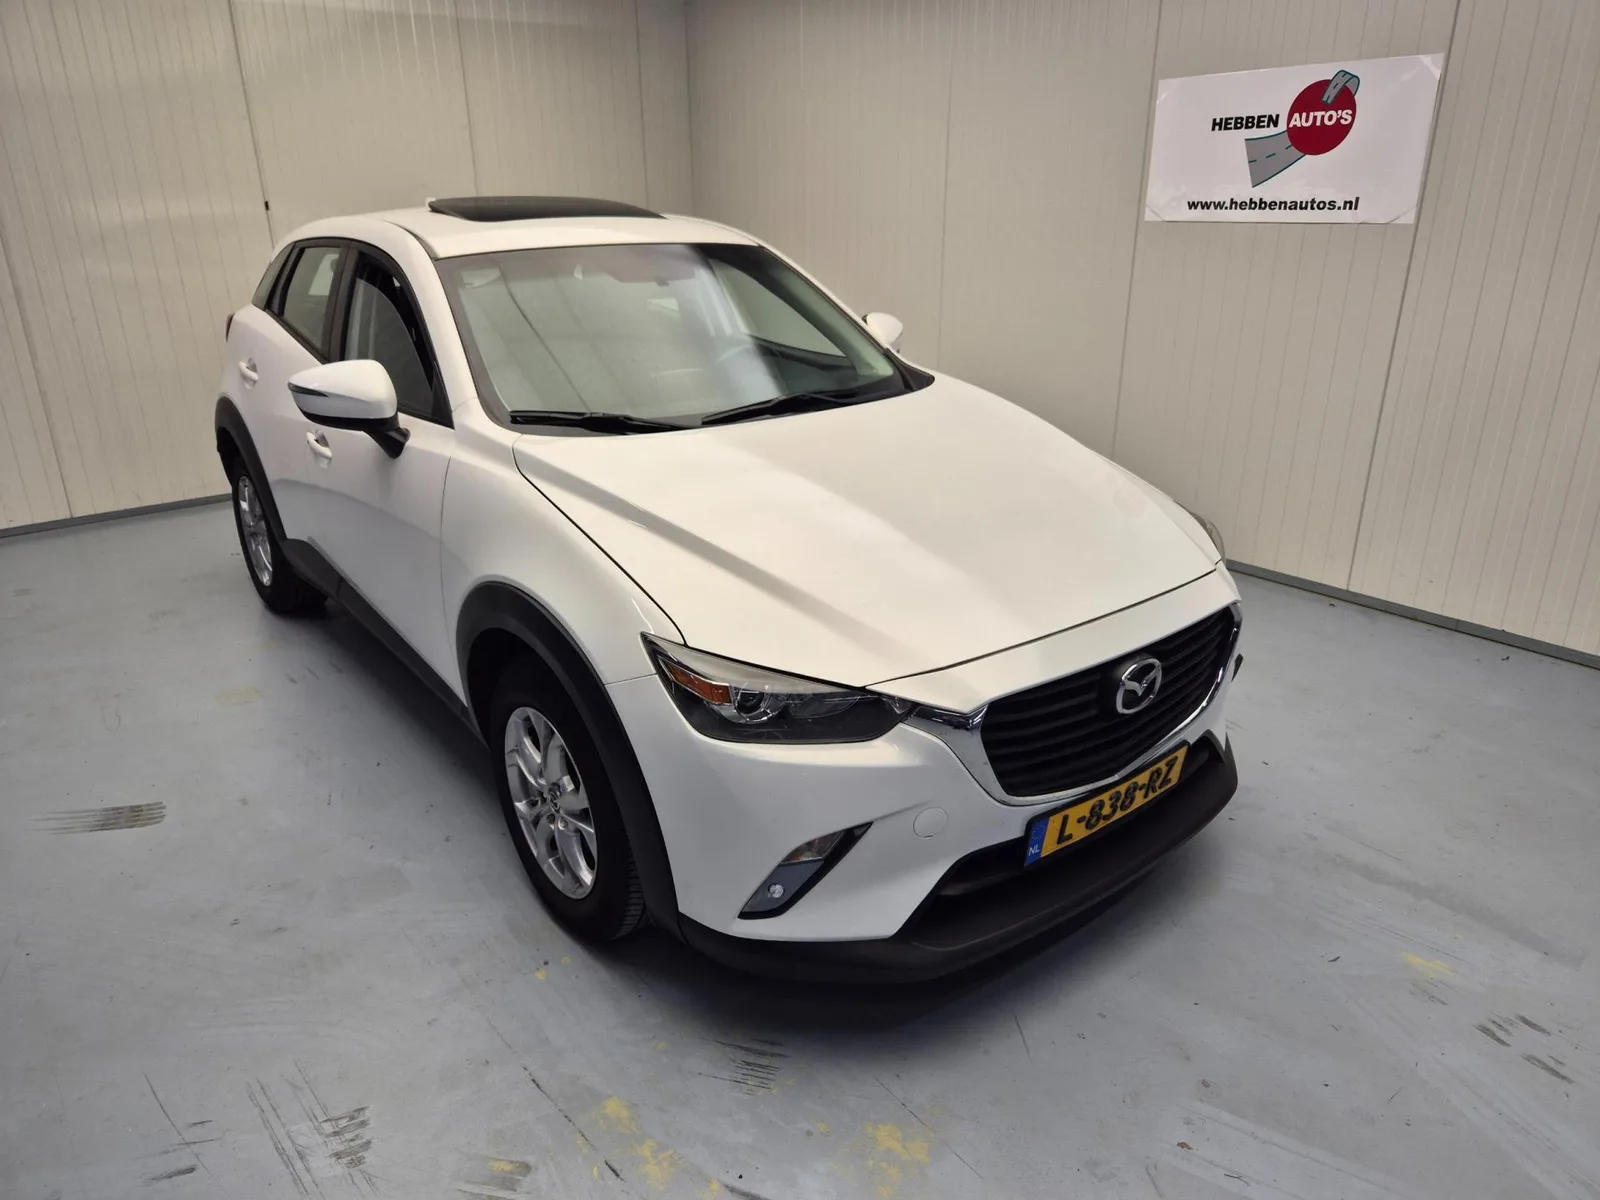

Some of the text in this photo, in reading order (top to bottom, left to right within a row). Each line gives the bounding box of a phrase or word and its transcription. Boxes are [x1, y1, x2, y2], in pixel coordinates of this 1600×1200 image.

[1211, 109, 1353, 132] HEBBEN AUTO'S
[1187, 197, 1360, 212] www.hebbenautos.nl
[1056, 755, 1179, 845] L-838-RZ
[1028, 845, 1040, 857] NL
